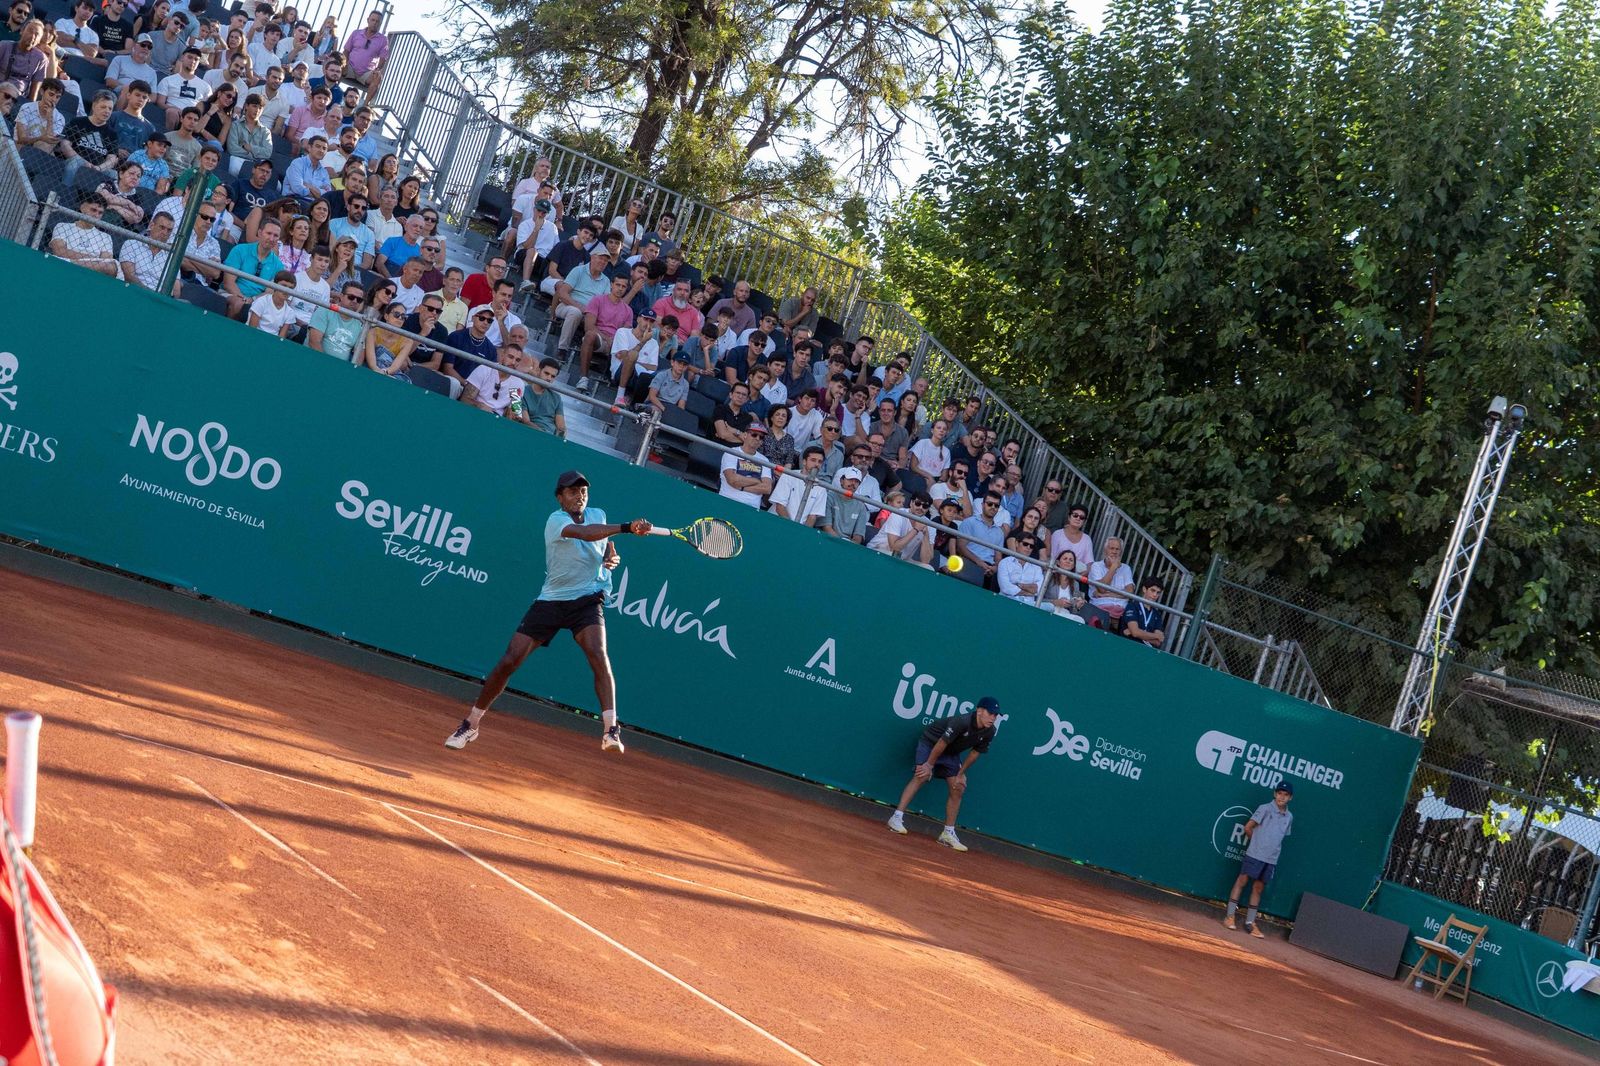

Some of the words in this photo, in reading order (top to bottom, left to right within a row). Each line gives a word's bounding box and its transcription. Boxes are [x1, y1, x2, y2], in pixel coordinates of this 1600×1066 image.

[0, 422, 58, 463] ERS
[335, 480, 472, 556] Sevilla
[603, 566, 737, 659] dalucía
[784, 665, 806, 680] Junta
[806, 673, 817, 682] de
[816, 677, 852, 693] Andalucía
[1090, 750, 1142, 781] Sevilla
[1095, 737, 1147, 762] Diputación
[1226, 745, 1243, 754] ATP
[1247, 743, 1344, 790] CHALLENGER
[1241, 762, 1284, 790] TOUR
[1423, 916, 1502, 955] MeredesBenz
